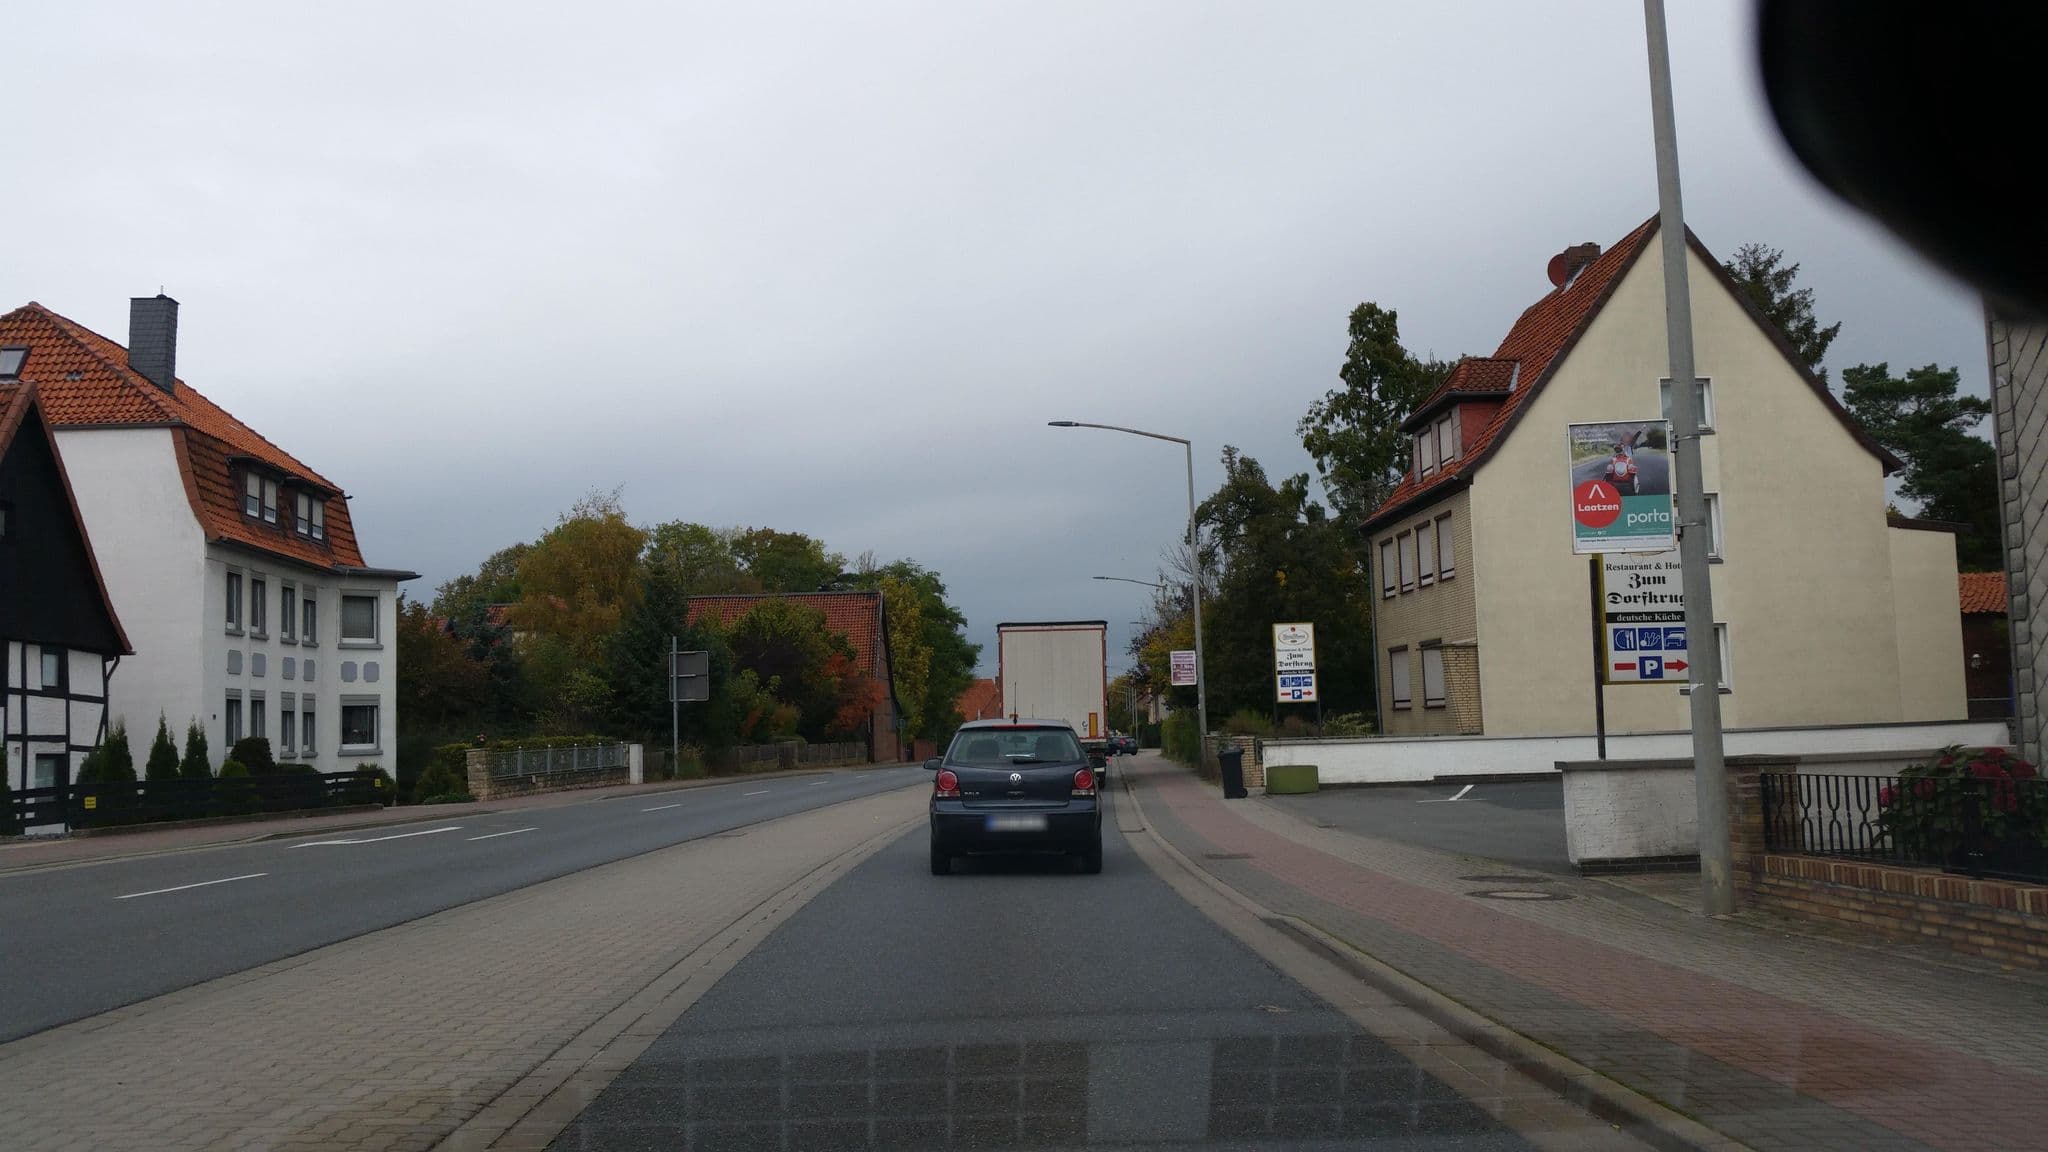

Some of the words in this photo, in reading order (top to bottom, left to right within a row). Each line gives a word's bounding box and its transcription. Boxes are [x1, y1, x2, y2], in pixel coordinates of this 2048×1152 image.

[1578, 503, 1620, 512] Laatzen
[1627, 508, 1669, 527] porta
[1606, 563, 1652, 571] Restaurant
[1654, 562, 1662, 570] &
[1665, 562, 1683, 570] Hot
[1628, 573, 1667, 589] Zum
[1616, 614, 1653, 622] deutsche
[1654, 613, 1682, 621] Küche
[1645, 659, 1659, 676] P
